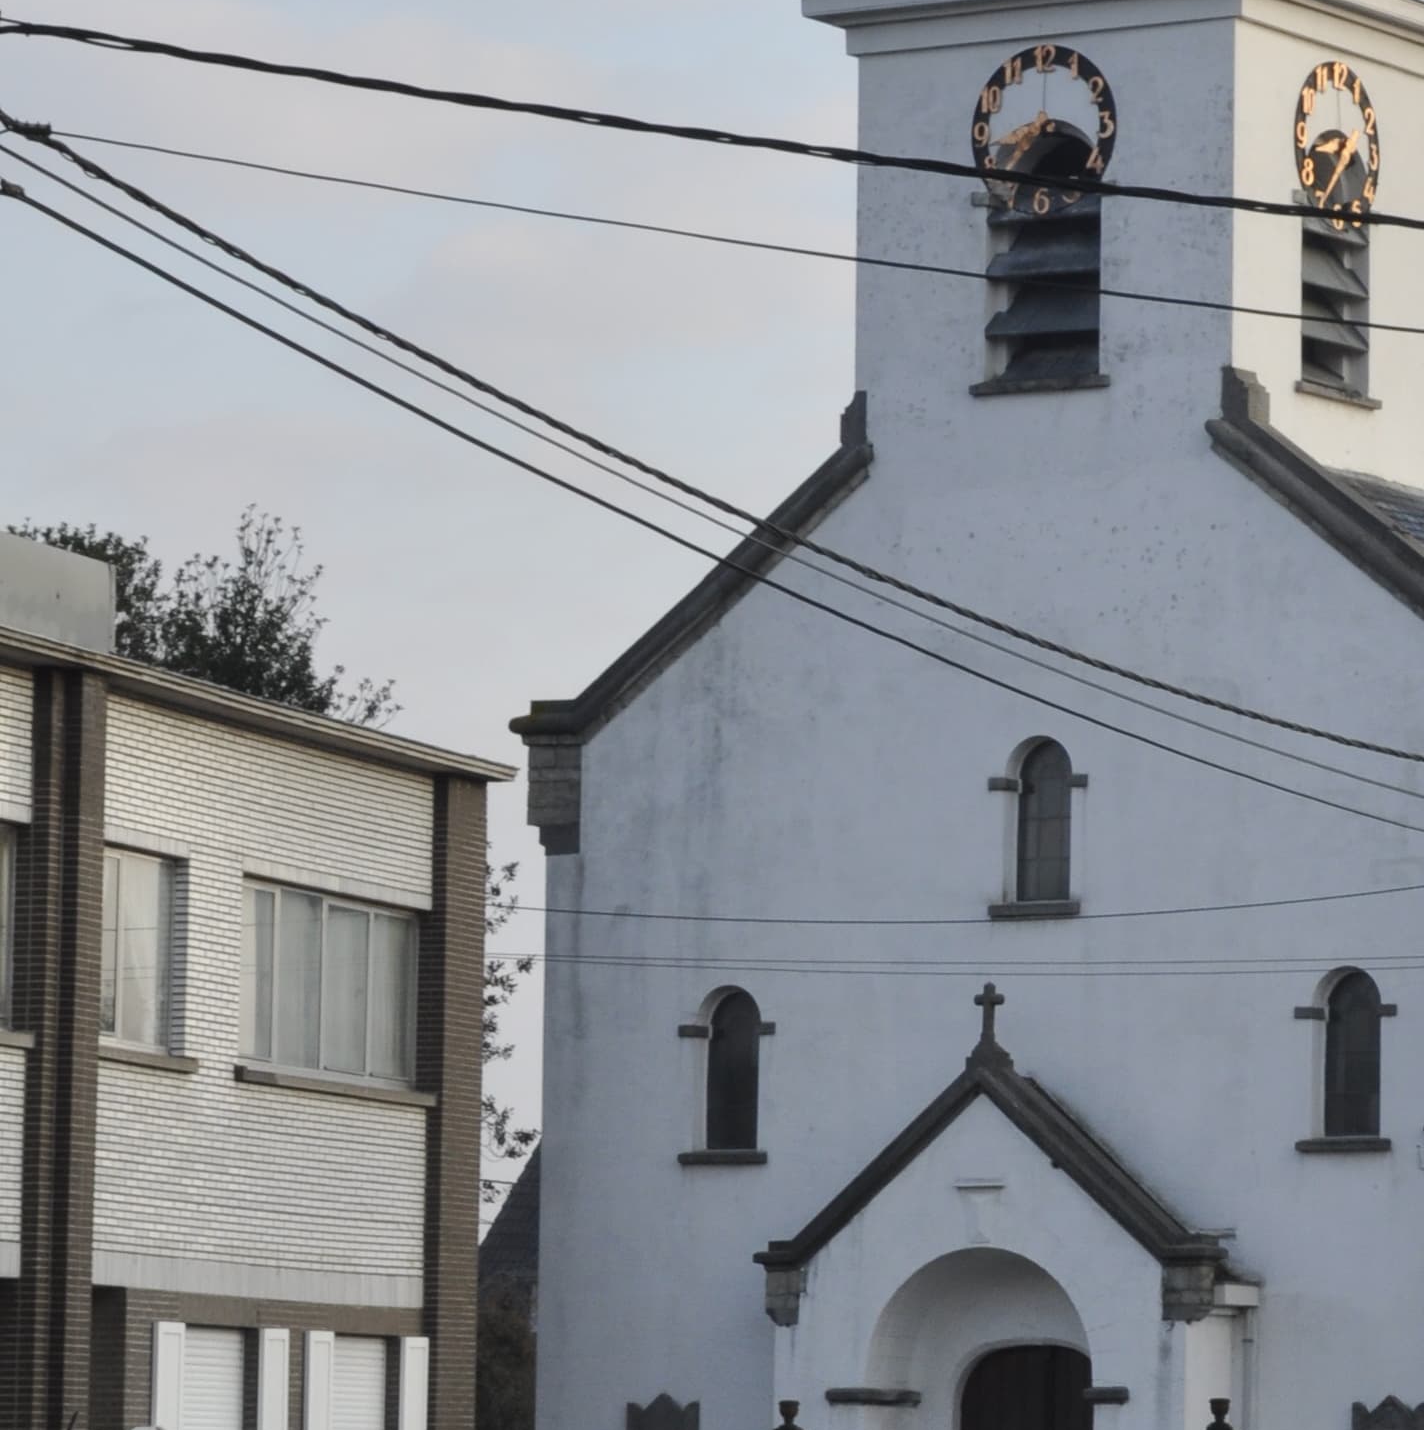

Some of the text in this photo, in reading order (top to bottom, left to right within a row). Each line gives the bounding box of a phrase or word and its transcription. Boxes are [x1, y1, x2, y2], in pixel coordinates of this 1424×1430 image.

[1003, 57, 1023, 85] 11
[1034, 44, 1056, 73] 12
[1068, 52, 1079, 80] 1
[1089, 76, 1105, 104] 2
[1315, 65, 1328, 92] 11
[1333, 62, 1348, 91] 12
[980, 85, 1001, 113] 10
[1353, 77, 1362, 105] 1
[974, 122, 989, 148] 9
[1098, 111, 1115, 139] 3
[1364, 107, 1375, 135] 2
[1296, 122, 1308, 149] 9
[1086, 147, 1105, 174] 4
[1368, 143, 1379, 171] 3
[1301, 157, 1314, 186] 8
[1033, 187, 1050, 215] 6
[1363, 176, 1375, 204] 4
